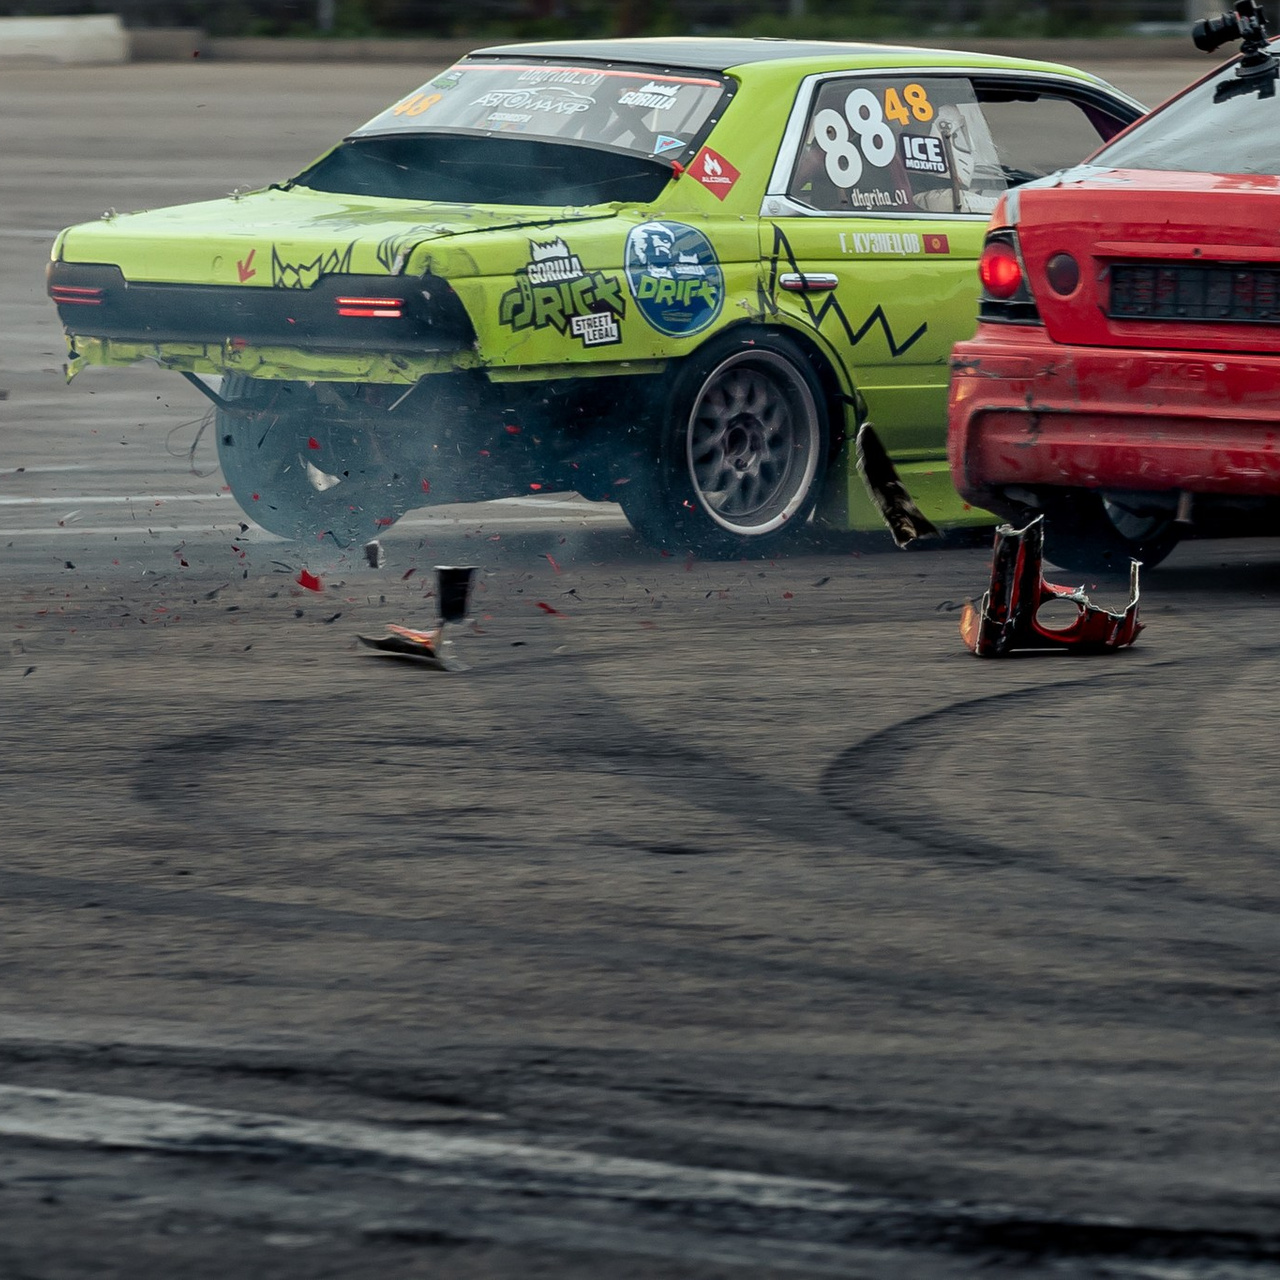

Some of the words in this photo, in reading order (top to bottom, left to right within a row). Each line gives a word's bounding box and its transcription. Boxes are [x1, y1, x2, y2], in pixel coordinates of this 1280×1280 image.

[393, 93, 442, 117] 48
[618, 91, 677, 110] GORILLA
[884, 83, 934, 125] 48
[813, 88, 896, 188] 88
[903, 136, 943, 162] ICE
[852, 232, 921, 256] КУЗНЕЦОВ
[527, 256, 584, 284] GORILLA
[637, 274, 718, 310] DRIFT
[573, 314, 611, 331] STREET
[587, 327, 616, 342] LEGAL
